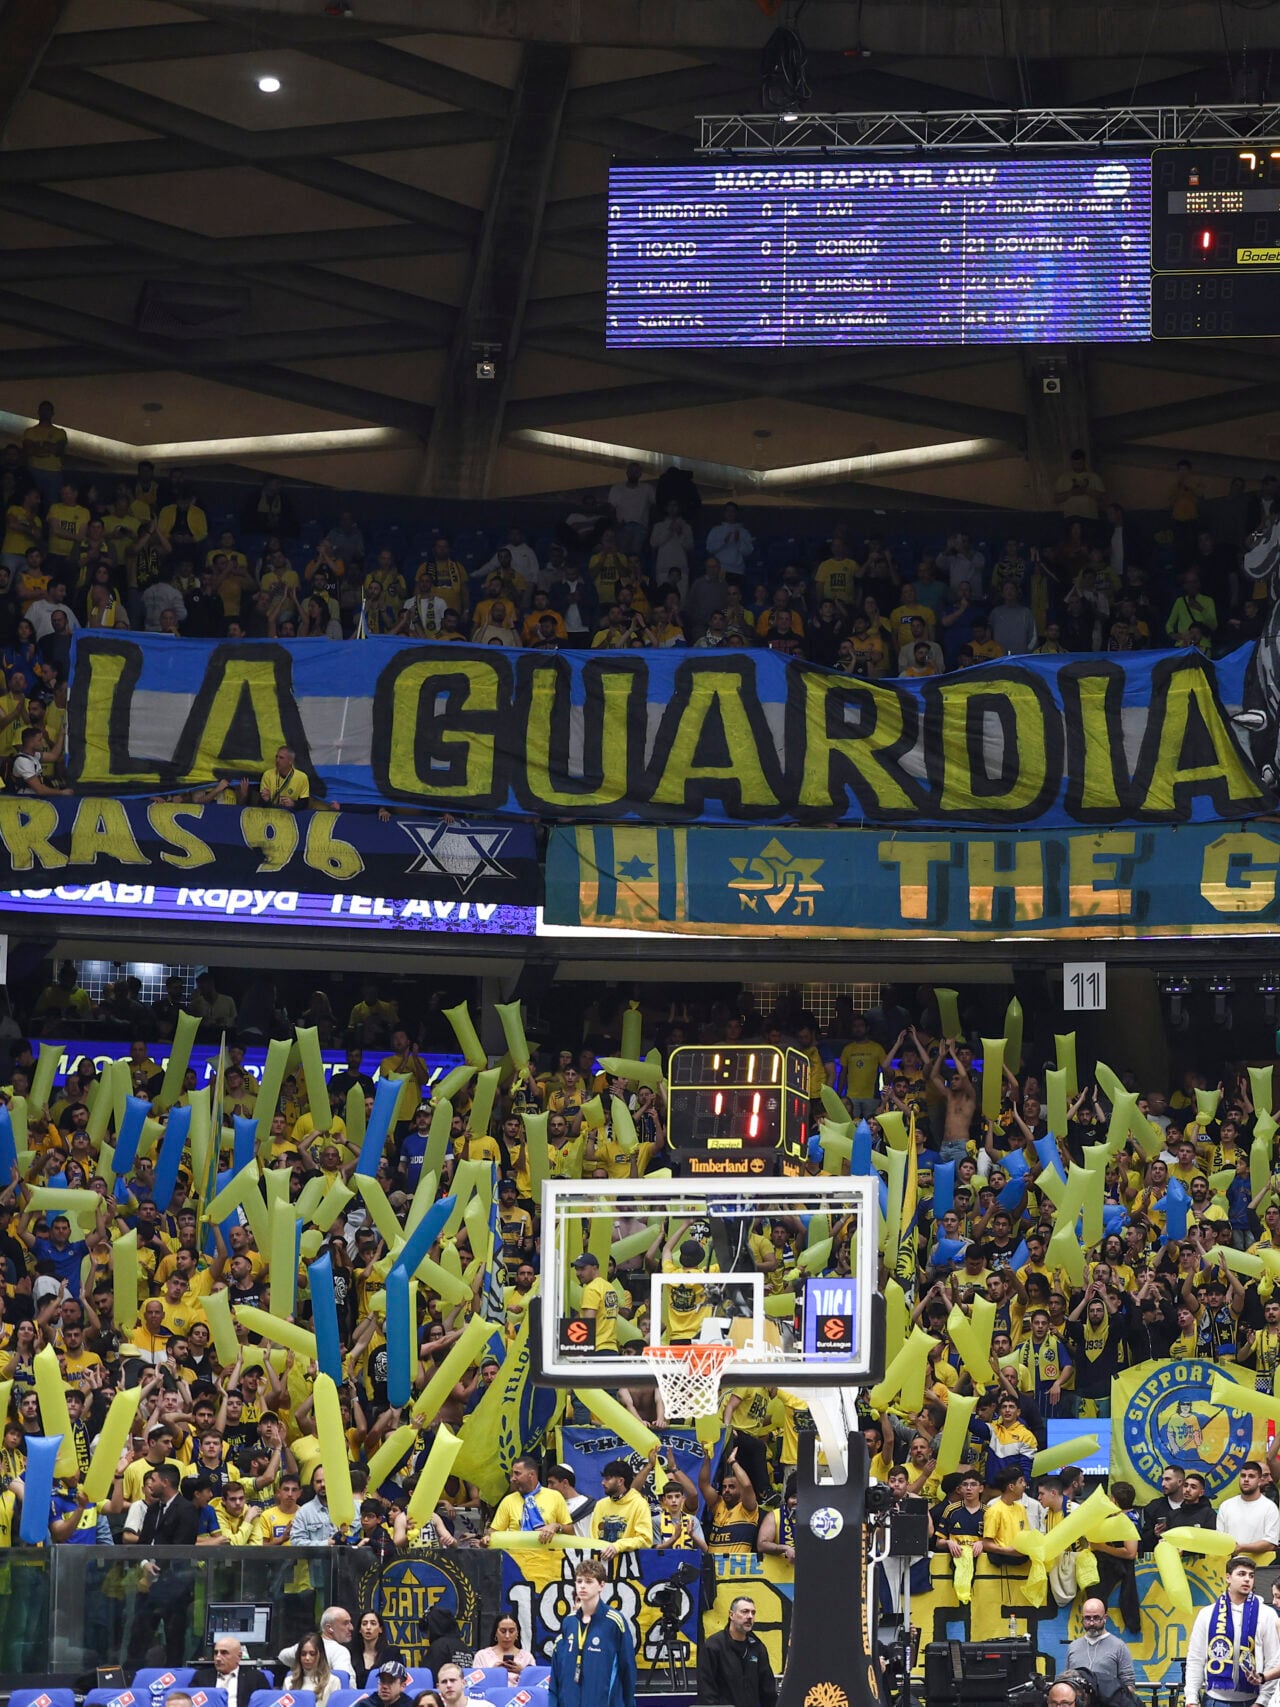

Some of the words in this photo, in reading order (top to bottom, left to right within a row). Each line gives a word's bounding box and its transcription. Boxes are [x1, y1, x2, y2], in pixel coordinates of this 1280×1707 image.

[714, 171, 815, 190] MACCABI
[820, 170, 893, 189] RAPYD
[899, 169, 938, 188] TEL
[943, 168, 997, 188] AVIV
[638, 242, 697, 257] HOARD
[815, 239, 879, 254] SORKIN
[966, 237, 985, 252] 21
[995, 236, 1063, 251] DOWTIN
[1068, 236, 1089, 250] JR
[1239, 250, 1280, 262] Bodet
[74, 646, 304, 788] LA
[384, 656, 1268, 814] GUARDIA
[240, 805, 366, 881] 96
[878, 830, 1137, 923] THE
[1070, 972, 1100, 1008] 11
[689, 1158, 749, 1173] Timberland
[1130, 1441, 1164, 1484] FOR
[1207, 1443, 1248, 1490] LIFE
[713, 1553, 764, 1577] THE
